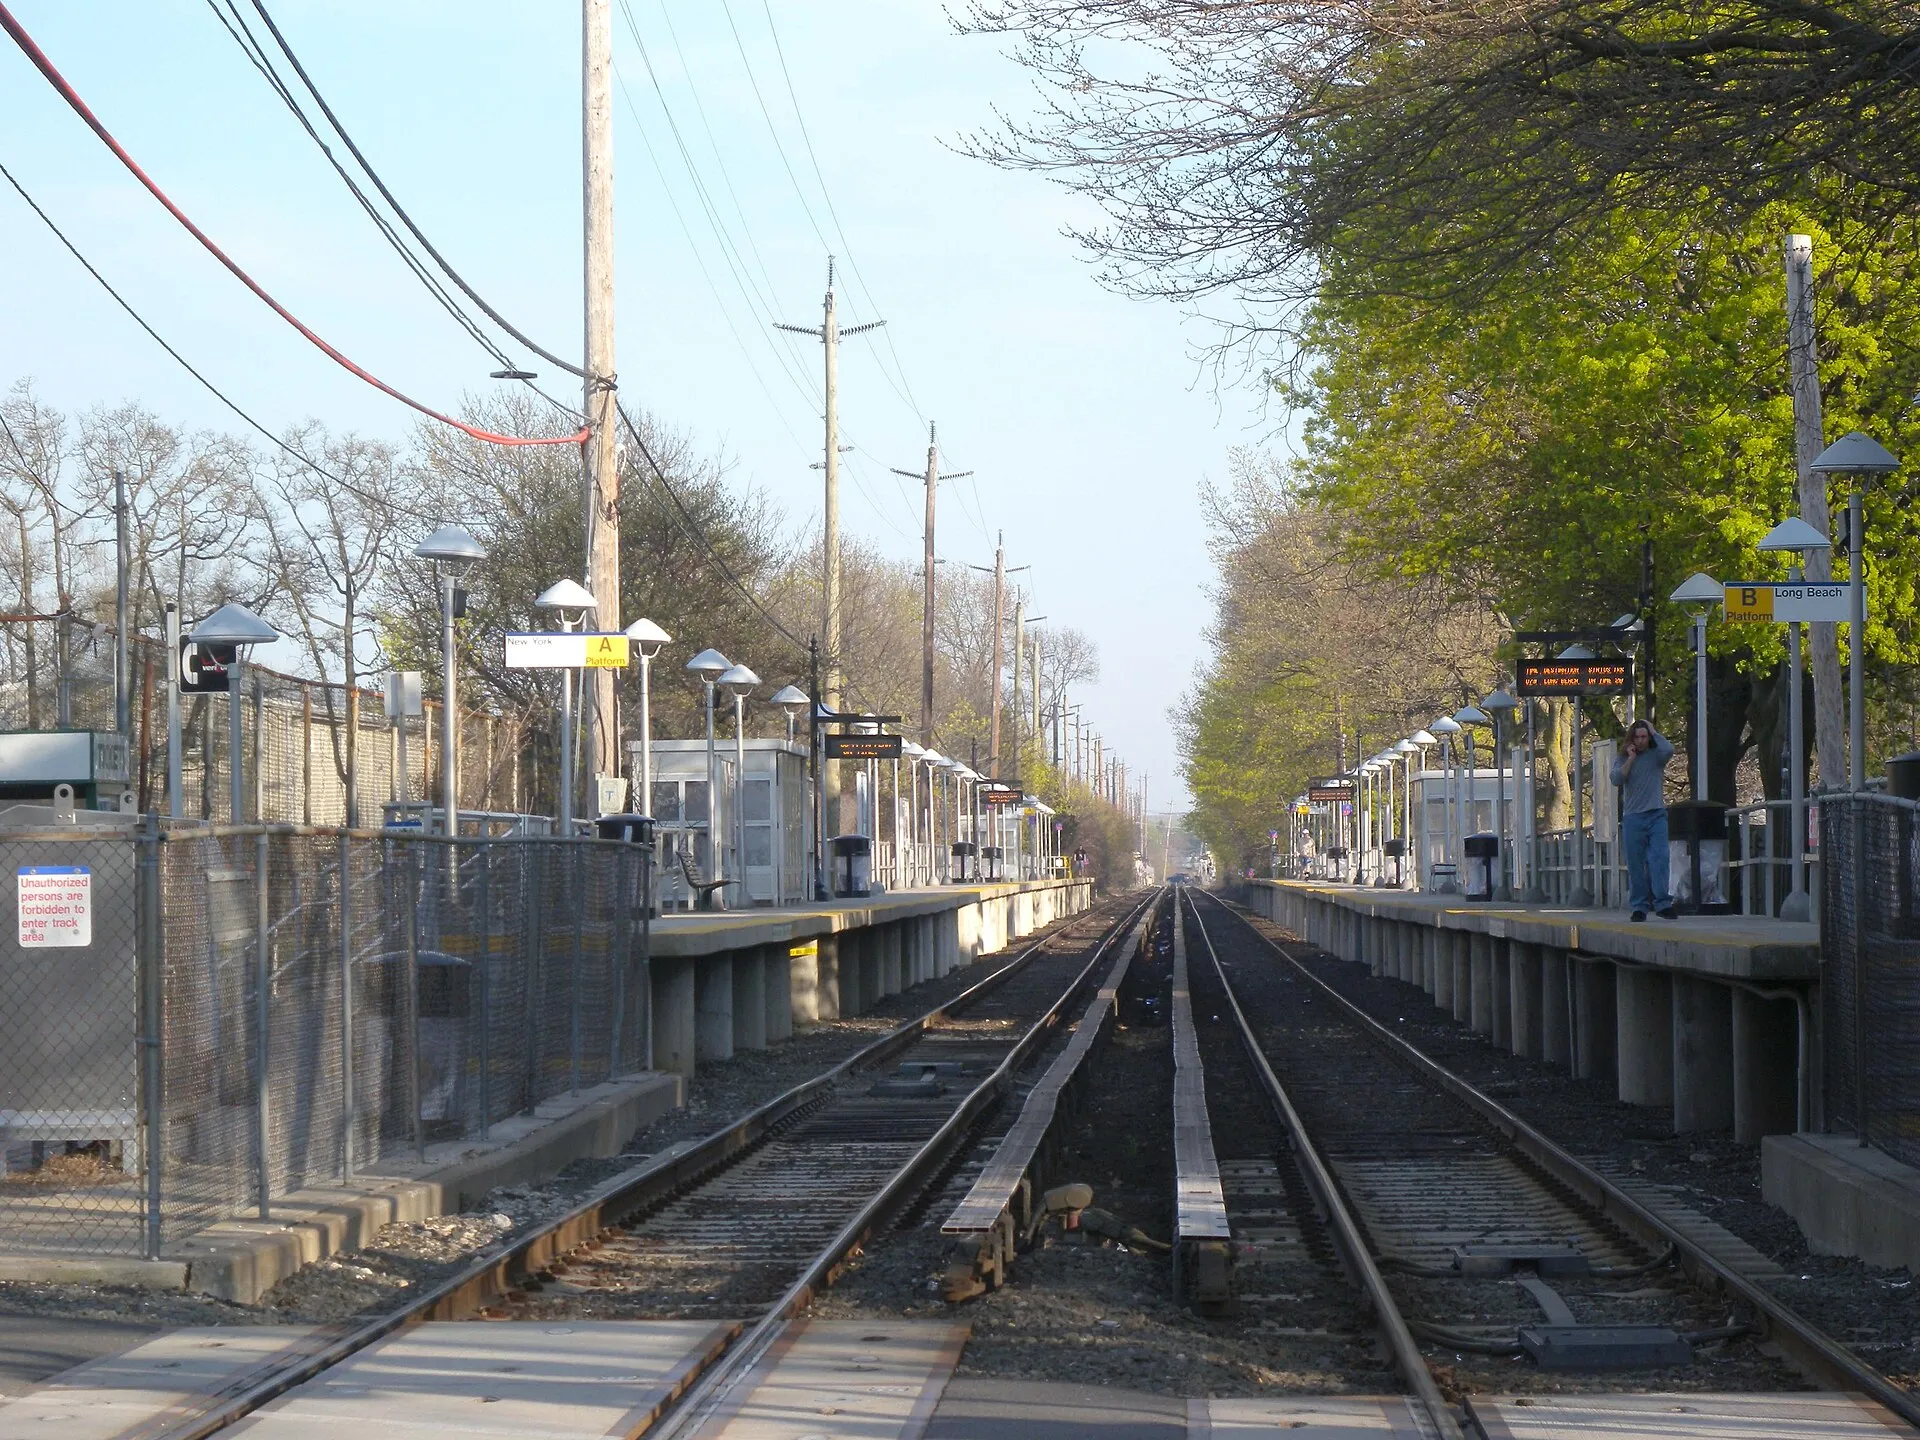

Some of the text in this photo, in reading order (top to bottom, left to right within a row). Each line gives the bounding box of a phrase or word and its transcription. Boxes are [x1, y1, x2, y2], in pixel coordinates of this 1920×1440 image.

[1741, 588, 1757, 606] B
[1775, 587, 1842, 599] Long Beach
[1726, 611, 1773, 622] Platform
[507, 637, 552, 646] New York
[599, 637, 612, 652] A
[586, 656, 626, 666] Platform
[20, 877, 88, 888] Unauthorized
[21, 892, 84, 903] persons are
[21, 904, 85, 915] forbidden to
[21, 917, 78, 928] enter track
[21, 933, 44, 942] area
